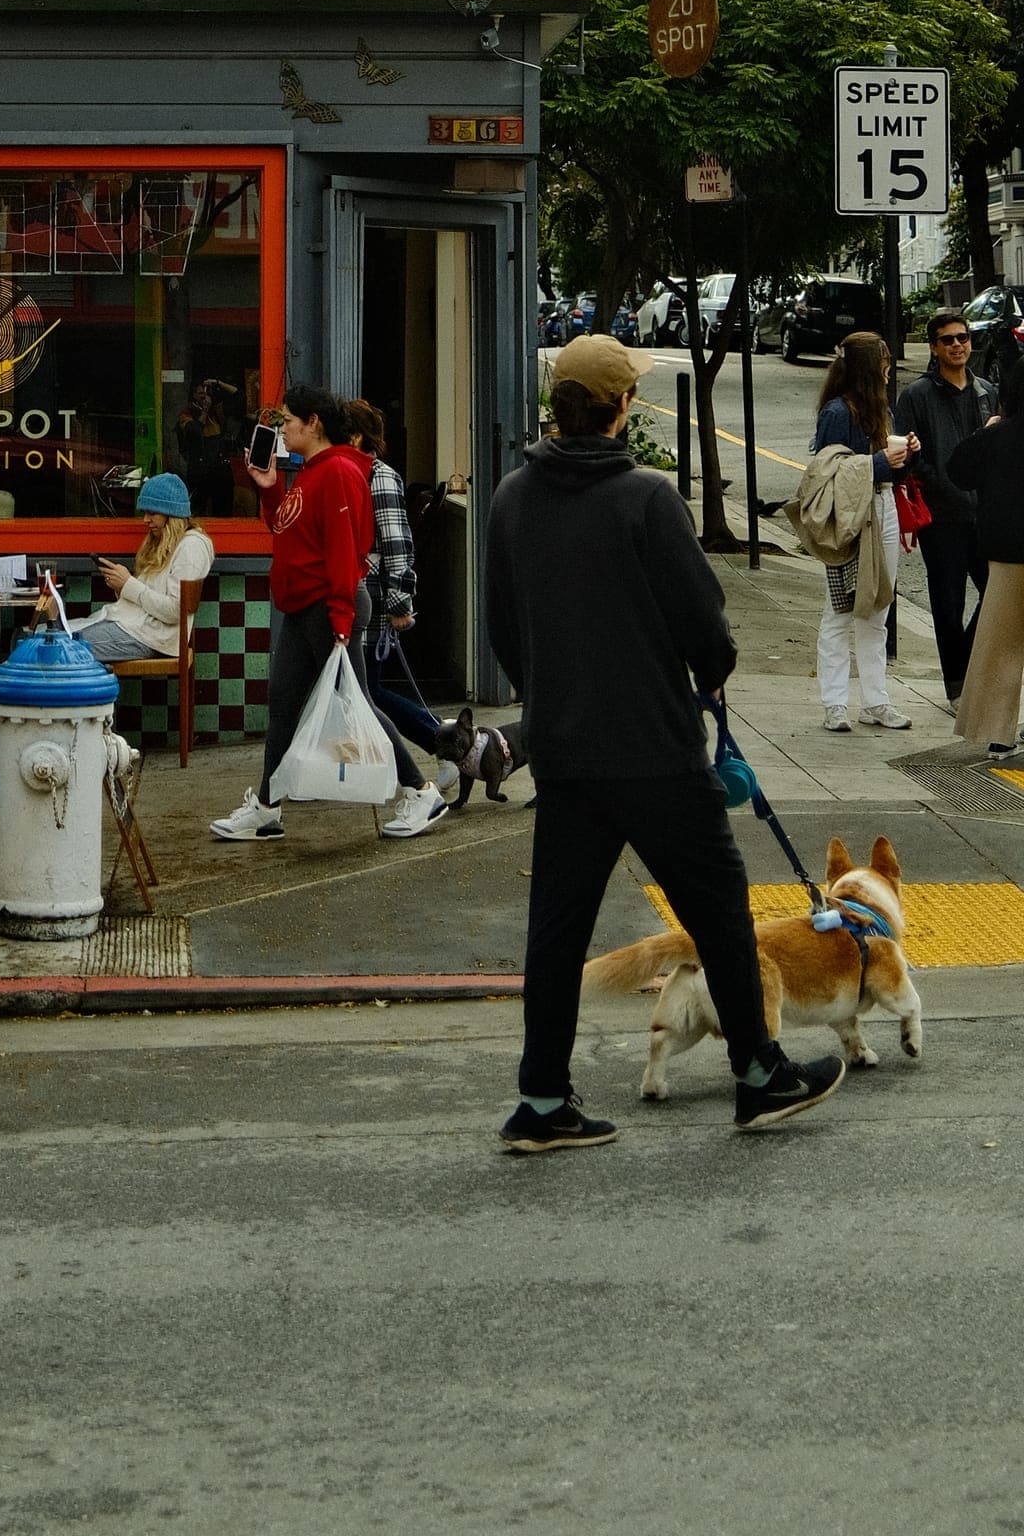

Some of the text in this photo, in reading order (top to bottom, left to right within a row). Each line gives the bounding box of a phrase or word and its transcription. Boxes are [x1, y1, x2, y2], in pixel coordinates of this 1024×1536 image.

[656, 23, 706, 56] SPOT
[846, 82, 939, 105] SPEED
[432, 120, 520, 141] 3565
[857, 116, 928, 138] LIMIT
[699, 170, 719, 181] ANY
[857, 149, 928, 201] 15
[698, 182, 721, 193] TIME
